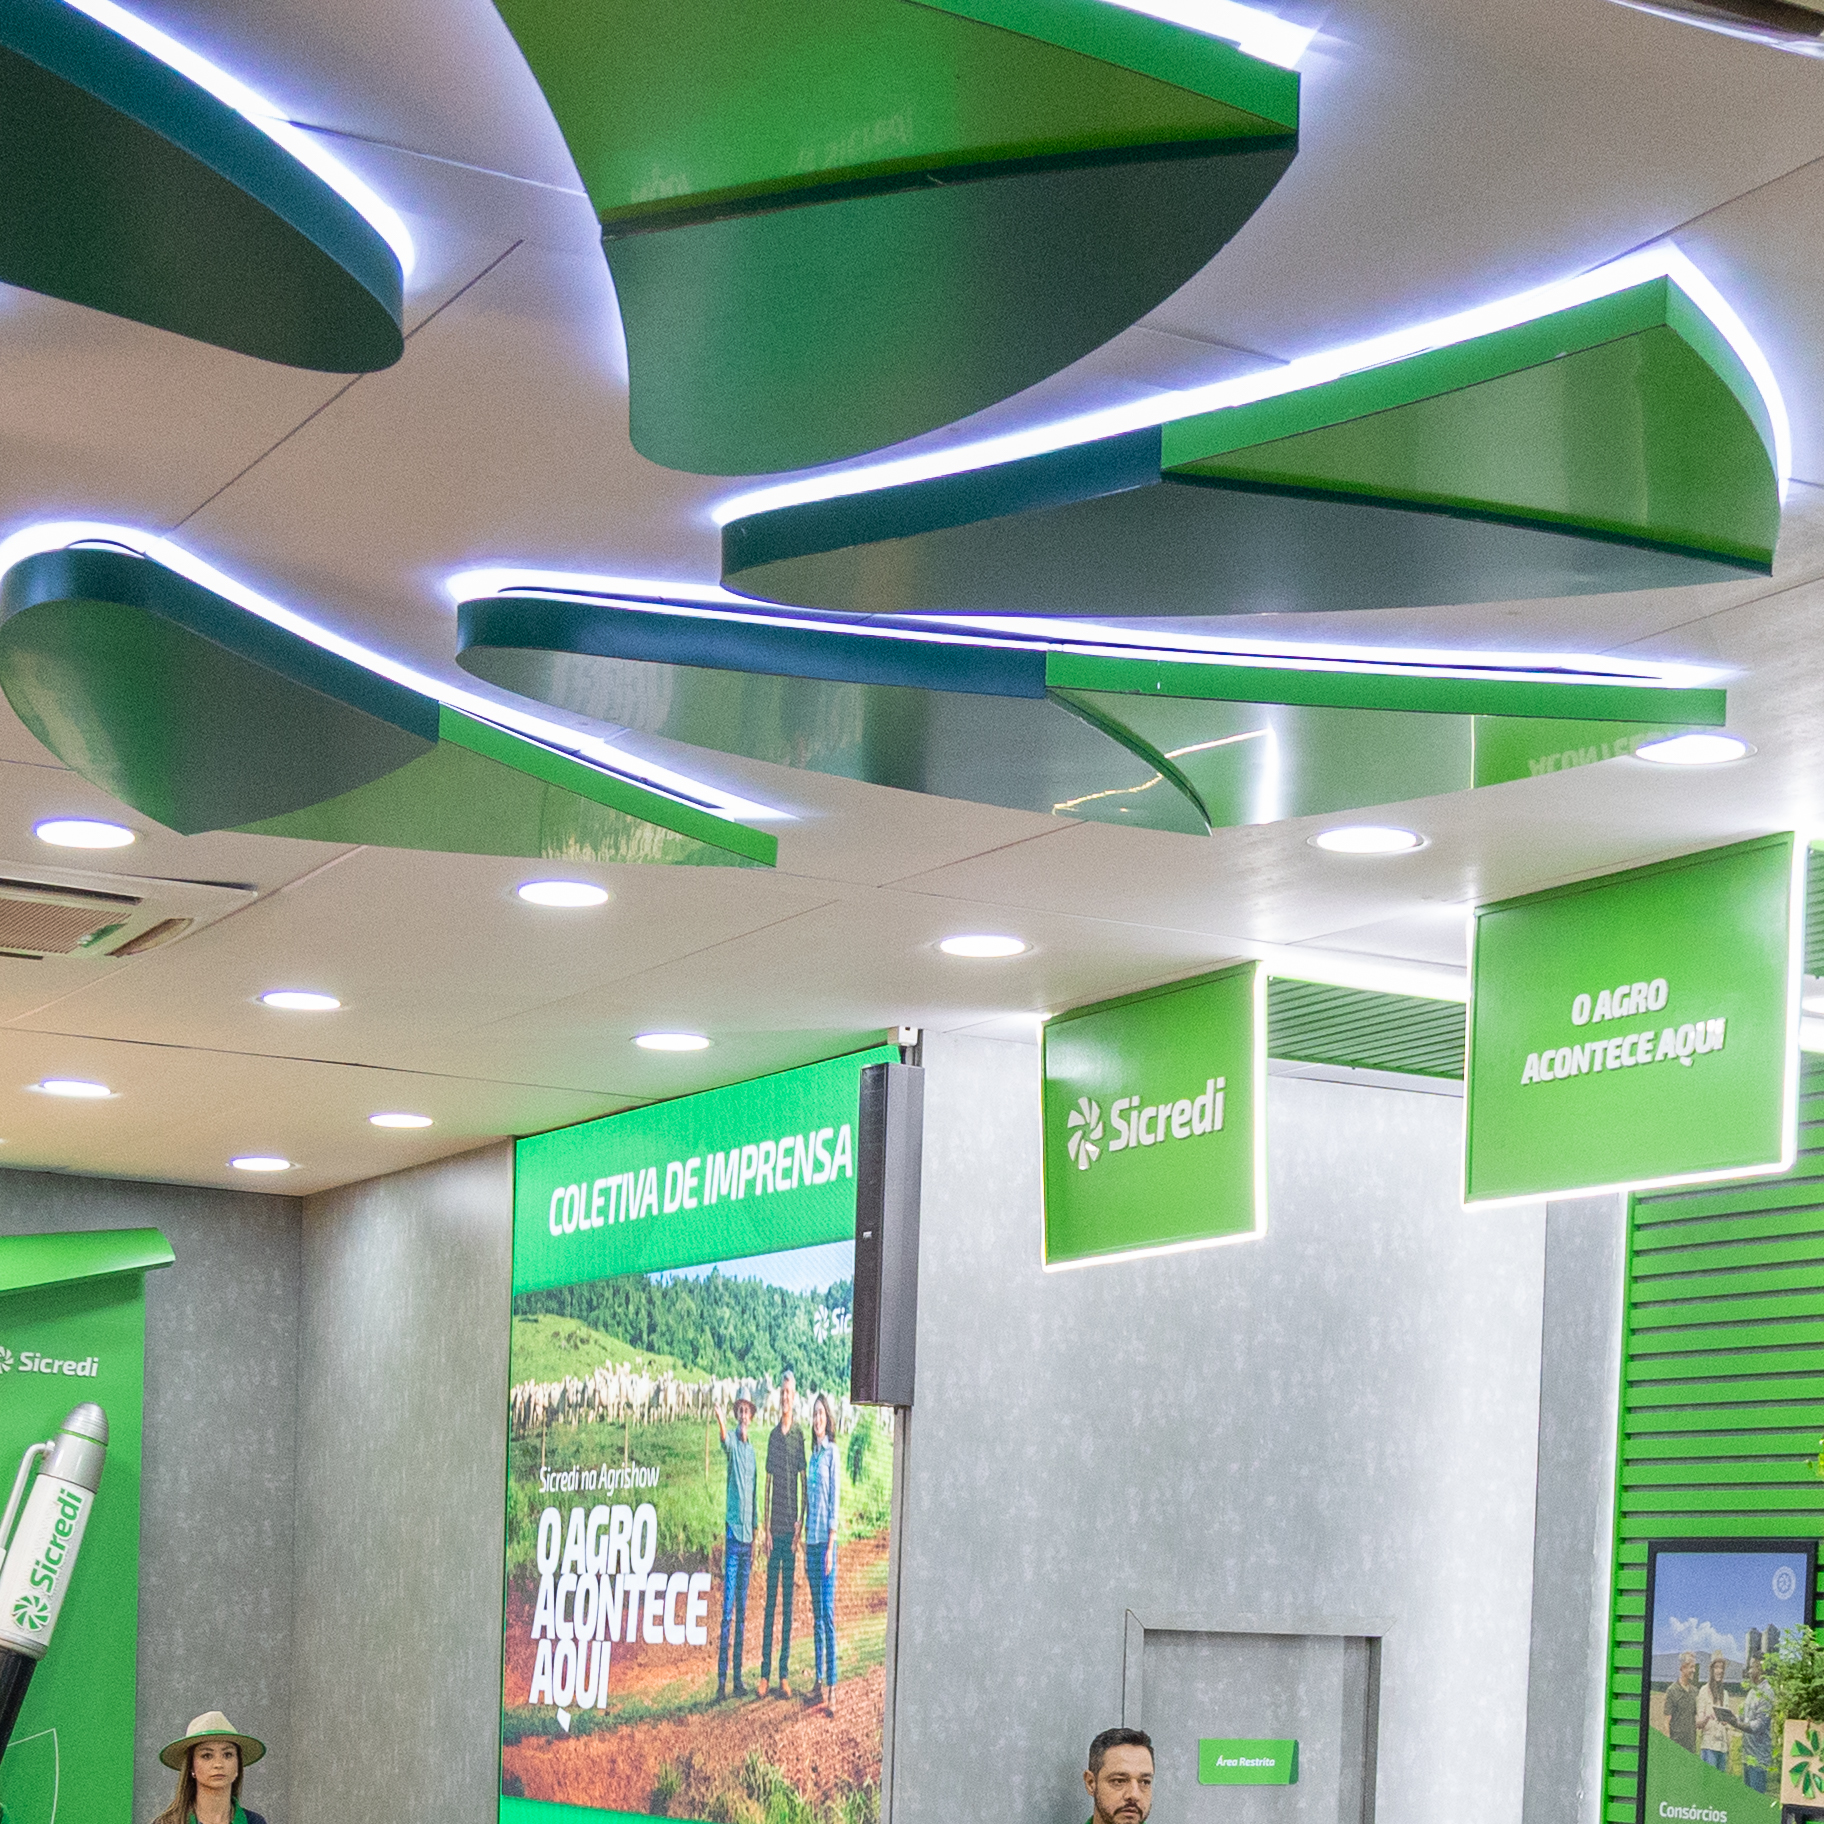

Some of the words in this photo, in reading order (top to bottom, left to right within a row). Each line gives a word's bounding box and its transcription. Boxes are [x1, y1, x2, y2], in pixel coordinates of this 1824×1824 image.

[1572, 993, 1593, 1027] O
[1593, 977, 1669, 1021] AGRO
[1521, 1027, 1654, 1086] ACONTECE
[1653, 1016, 1727, 1067] AQUI
[1108, 1077, 1226, 1152] Sicredi
[549, 1165, 659, 1236] COLETIVA
[663, 1157, 702, 1214] DE
[703, 1124, 853, 1206] IMPRENSA
[18, 1350, 100, 1379] Sicredi
[539, 1465, 579, 1494] Sicredi
[581, 1472, 597, 1492] na
[598, 1461, 660, 1498] Agrishow
[28, 1487, 84, 1593] Sicredi
[536, 1506, 562, 1575] O
[561, 1503, 658, 1575] AGRO
[531, 1572, 712, 1646] ACONTECE
[529, 1638, 611, 1732] AQUI
[1216, 1754, 1238, 1767] Área
[1659, 1801, 1728, 1824] Consórcios
